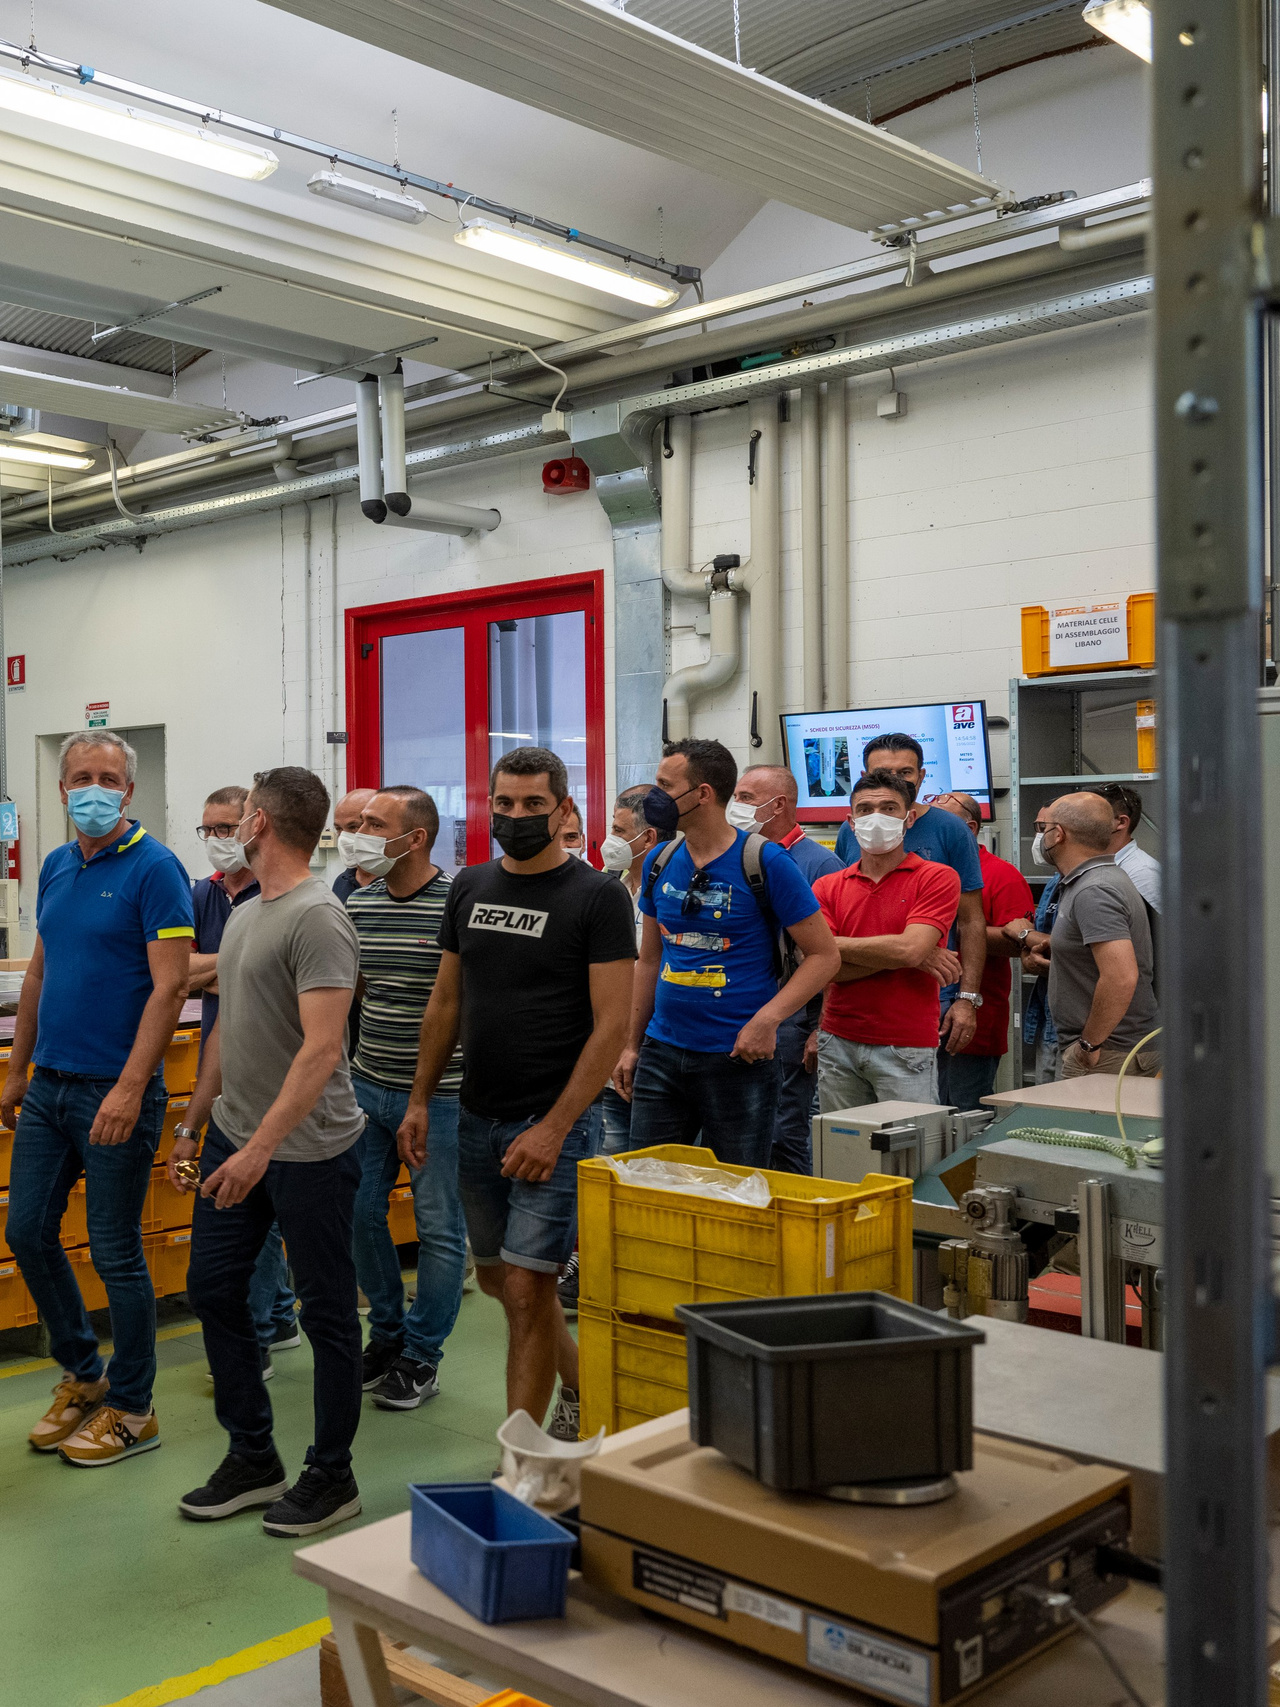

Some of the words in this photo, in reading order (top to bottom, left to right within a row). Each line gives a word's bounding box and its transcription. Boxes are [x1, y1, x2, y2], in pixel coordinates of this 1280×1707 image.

[1057, 618, 1097, 628] MATERIALE
[1098, 616, 1118, 624] CELLE
[1064, 627, 1120, 639] ASSEMBLAGGIO
[1075, 639, 1102, 648] LIBANO
[953, 722, 975, 730] ave
[3, 811, 15, 836] 2
[472, 907, 543, 931] REPLAY
[1125, 1222, 1153, 1239] KRELL
